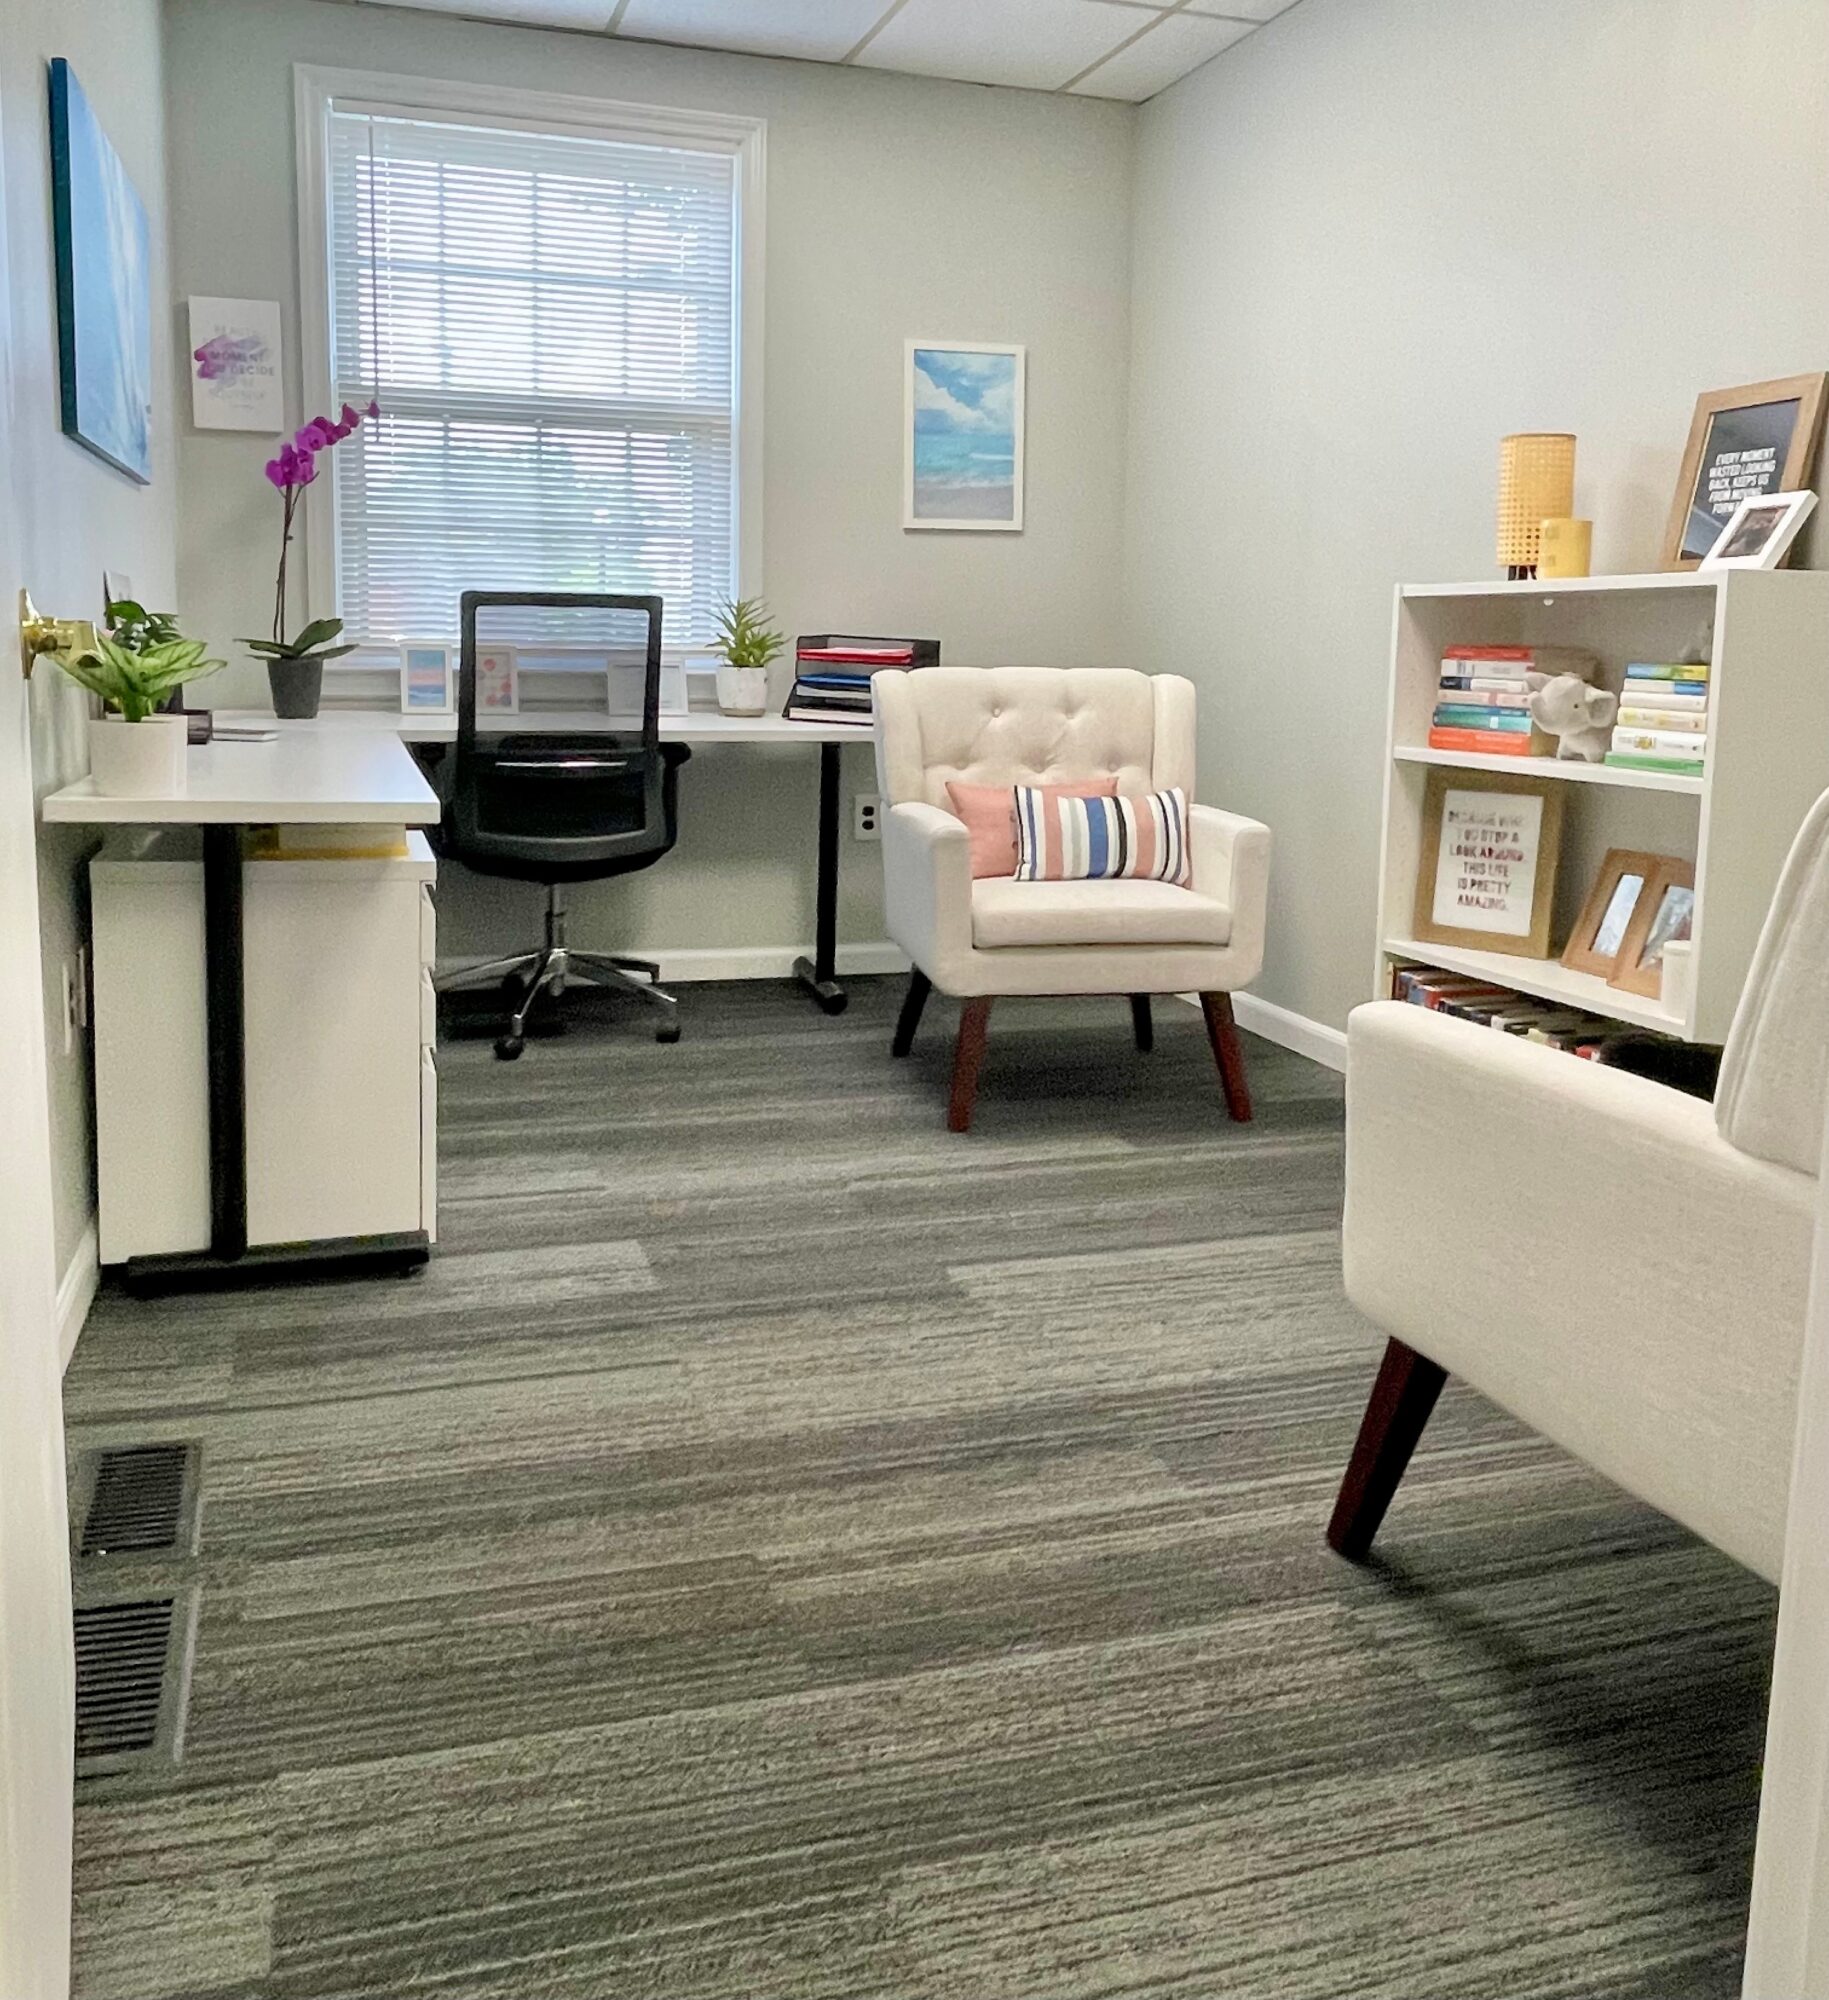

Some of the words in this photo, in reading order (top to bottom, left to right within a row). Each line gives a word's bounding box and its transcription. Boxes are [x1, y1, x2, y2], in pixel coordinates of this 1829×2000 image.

[230, 365, 275, 376] DECIDE
[1449, 844, 1478, 858] LOOK
[1463, 861, 1486, 876] THIS
[1488, 864, 1509, 877] LIFE
[1470, 878, 1511, 895] PRETTY
